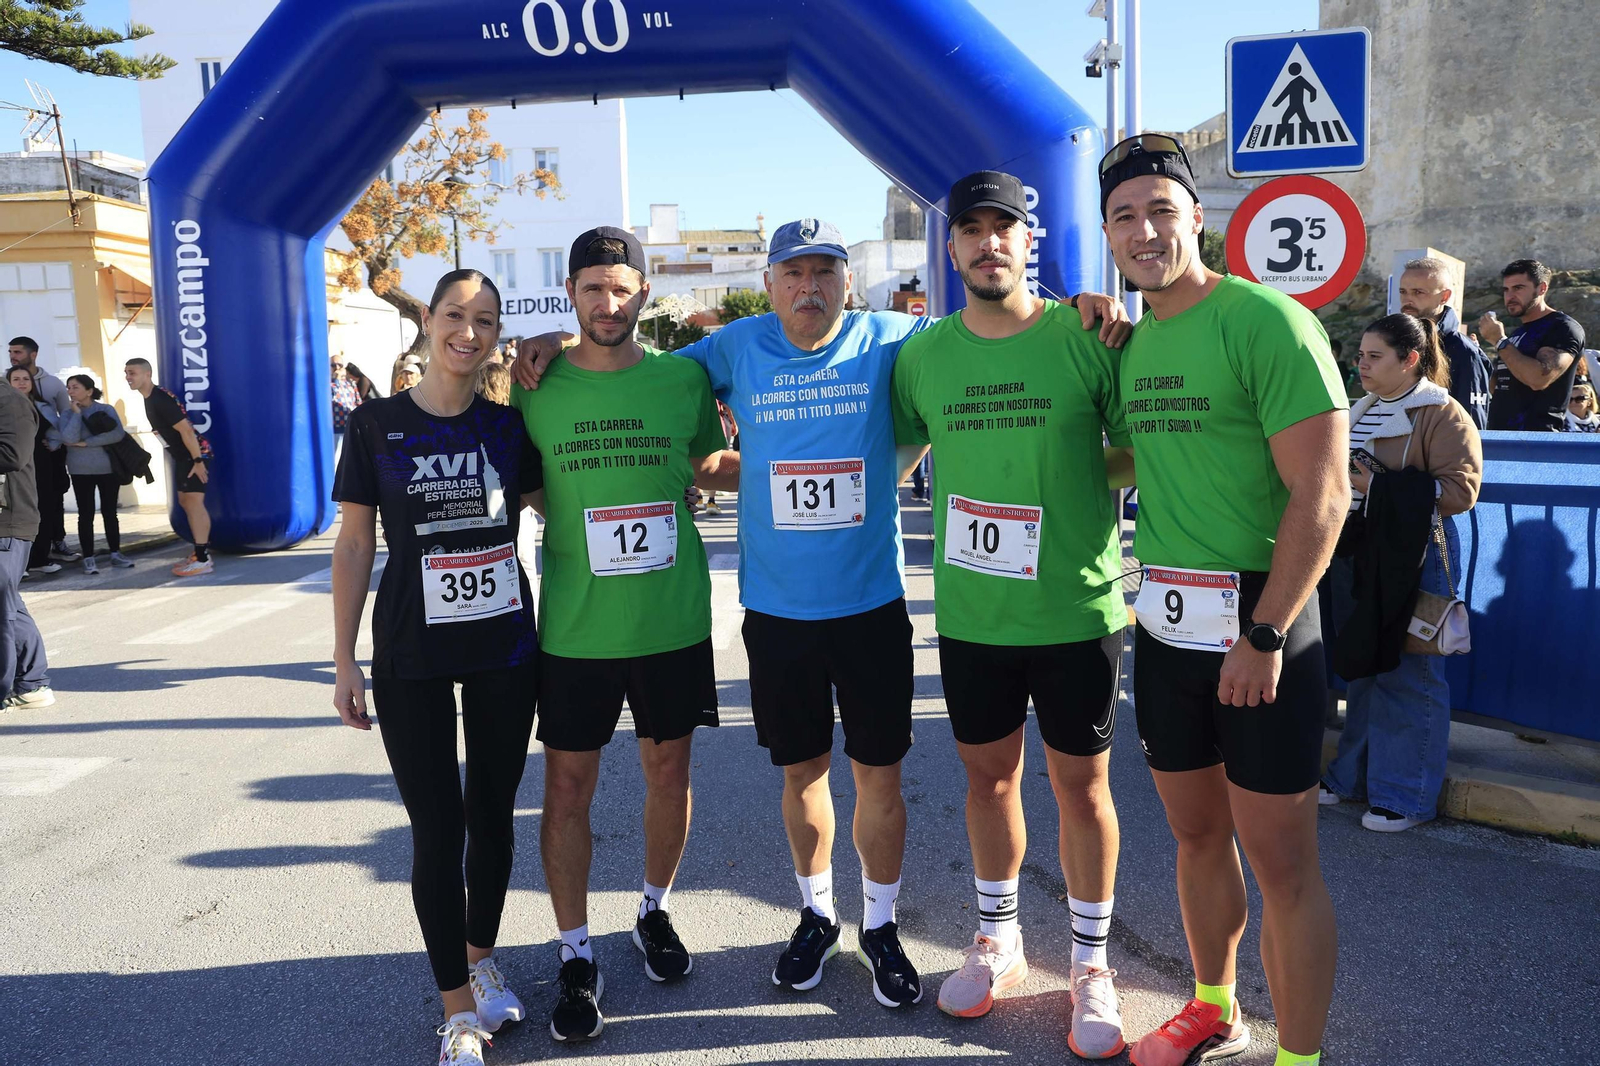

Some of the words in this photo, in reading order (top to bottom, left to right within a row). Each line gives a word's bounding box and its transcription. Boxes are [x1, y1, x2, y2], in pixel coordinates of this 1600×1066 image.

[482, 22, 509, 39] ALC
[522, 0, 629, 56] 0.0
[643, 12, 672, 28] VOL
[500, 297, 574, 315] EIDURI
[175, 220, 212, 434] cruzcampo
[774, 374, 795, 386] ESTA
[798, 368, 839, 384] CARRERA
[1135, 377, 1152, 392] ESTA
[1154, 375, 1183, 390] CARRERA
[752, 394, 760, 406] LA
[762, 391, 796, 404] CORRES
[798, 388, 818, 401] CON
[820, 383, 869, 398] NOSOTROS
[966, 386, 985, 397] ESTA
[988, 382, 1024, 395] CARRERA
[763, 411, 774, 422] VA
[777, 408, 795, 421] POR
[798, 408, 807, 419] TI
[809, 404, 831, 418] TITO
[834, 402, 858, 415] JUAN
[944, 404, 952, 415] LA
[955, 402, 986, 414] CORRES
[989, 401, 1004, 412] CON
[1007, 398, 1051, 411] NOSOTROS
[1128, 399, 1153, 414] CORRES
[575, 421, 597, 434] ESTA
[600, 419, 644, 431] CARRERA
[955, 421, 965, 431] VA
[968, 419, 984, 430] POR
[986, 419, 993, 429] TI
[996, 417, 1013, 428] TITO
[1016, 416, 1036, 427] JUAN
[1140, 420, 1156, 433] POR
[1158, 419, 1164, 432] TI
[554, 443, 563, 456] LA
[565, 439, 600, 453] CORRES
[604, 438, 622, 450] CON
[626, 437, 671, 448] NOSOTROS
[411, 452, 477, 481] XVI
[568, 460, 580, 472] VA
[582, 458, 600, 470] POR
[603, 456, 612, 468] TI
[614, 455, 635, 467] TITO
[638, 455, 660, 466] JUAN
[407, 480, 459, 494] CARRERA
[460, 478, 481, 488] DEL
[786, 478, 835, 510] 131
[425, 488, 482, 502] ESTRECHO
[428, 510, 446, 519] PEPE
[448, 508, 483, 518] SERRANO
[443, 500, 483, 510] MEMORIAL
[1003, 510, 1039, 518] ESTRECHO
[613, 523, 648, 554] 12
[968, 520, 1000, 554] 10
[961, 549, 975, 558] MIGUEL
[441, 567, 496, 603] 395
[1165, 590, 1183, 624] 9
